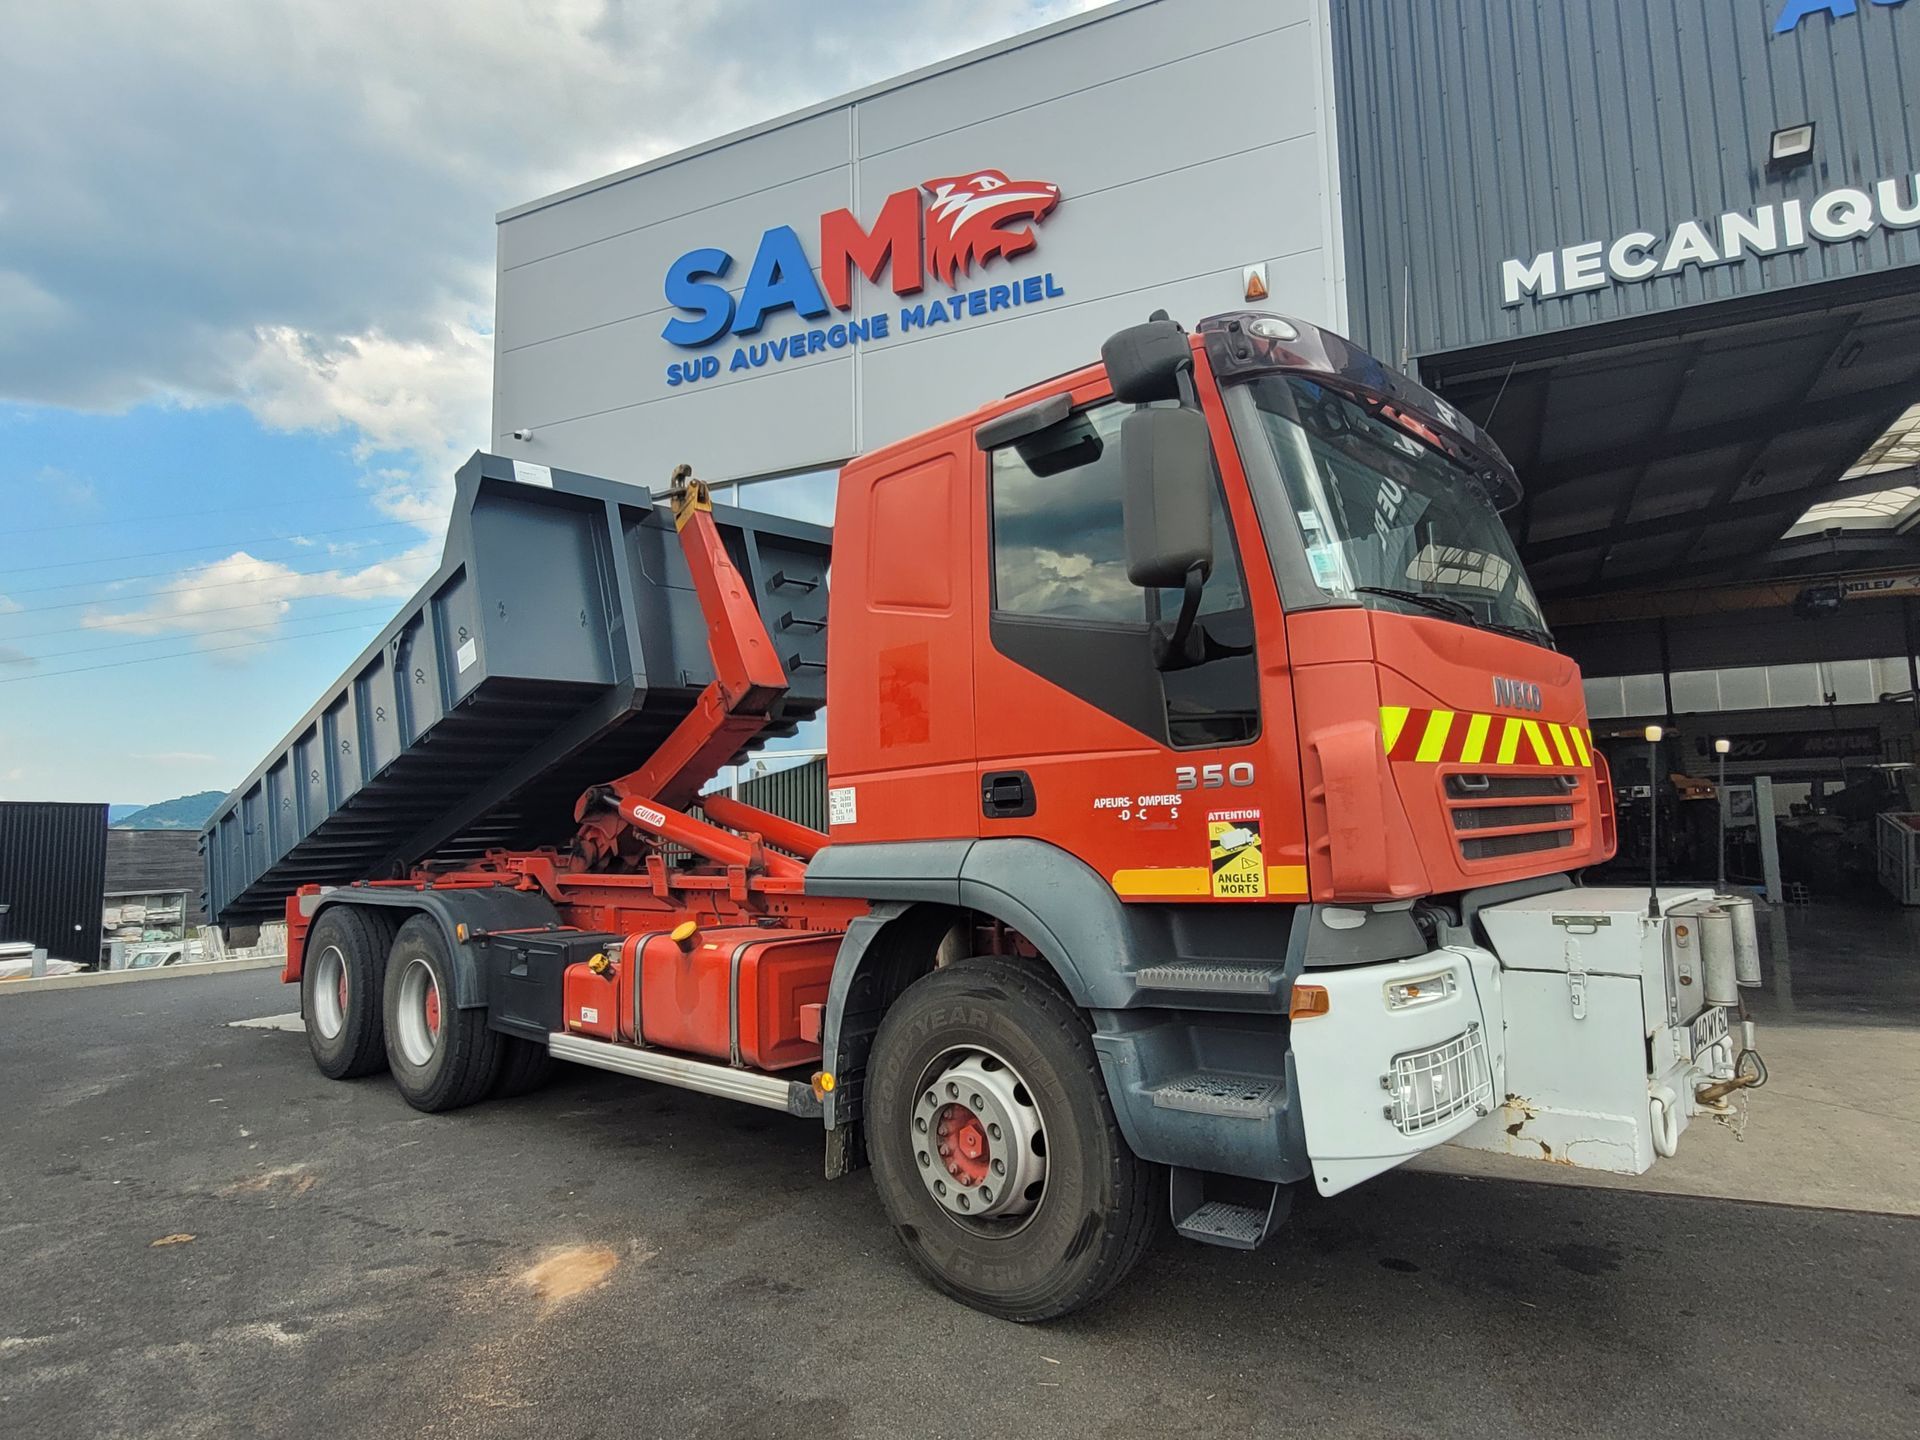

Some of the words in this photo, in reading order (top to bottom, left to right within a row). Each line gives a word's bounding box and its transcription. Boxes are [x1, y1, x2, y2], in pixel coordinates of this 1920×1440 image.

[661, 187, 925, 348] SAM
[667, 356, 720, 387] SUD
[728, 313, 890, 372] AUVERGNE
[900, 273, 1065, 332] MATERIEL
[1492, 675, 1543, 713] IVECO
[1175, 762, 1256, 790] 350
[1137, 794, 1182, 806] OMPIERS
[635, 807, 664, 825] GUIMA
[1208, 809, 1260, 822] ATTENTION
[1218, 873, 1260, 884] ANGLES
[1221, 884, 1259, 895] MORTS
